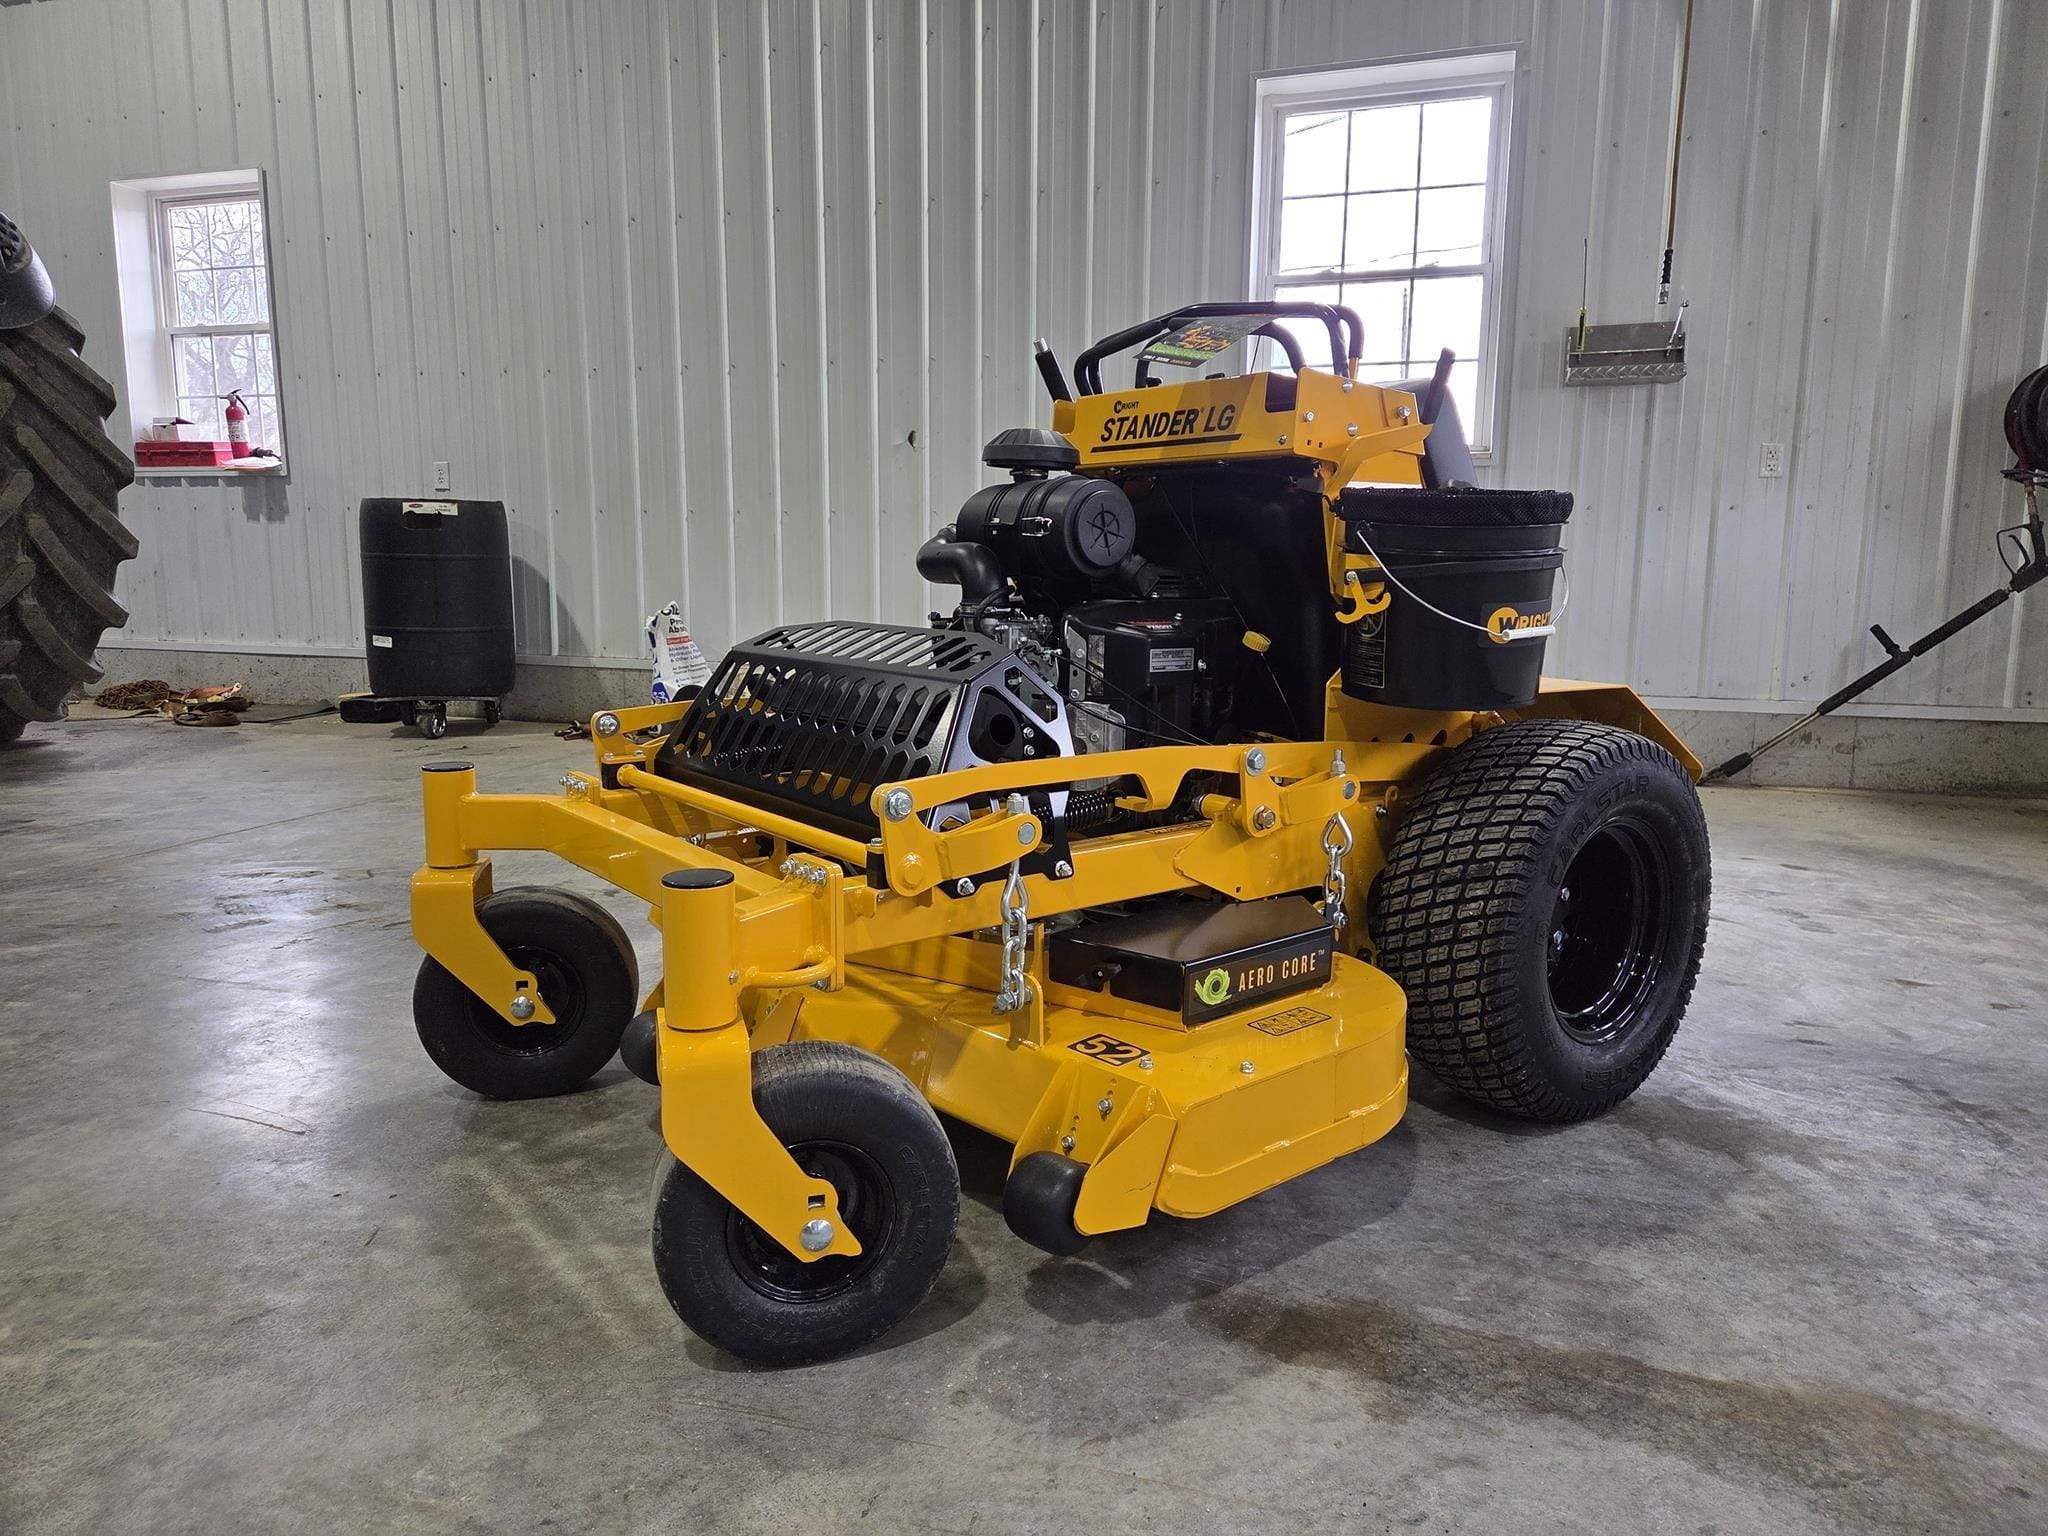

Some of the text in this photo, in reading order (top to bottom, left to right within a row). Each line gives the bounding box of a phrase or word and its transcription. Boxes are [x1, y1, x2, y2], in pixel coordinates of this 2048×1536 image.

[1101, 404, 1236, 442] STANDER LG
[1114, 401, 1139, 413] WRIGHT
[1239, 965, 1274, 992] AERO
[1282, 952, 1316, 979] CORE
[1076, 1036, 1141, 1065] 52
